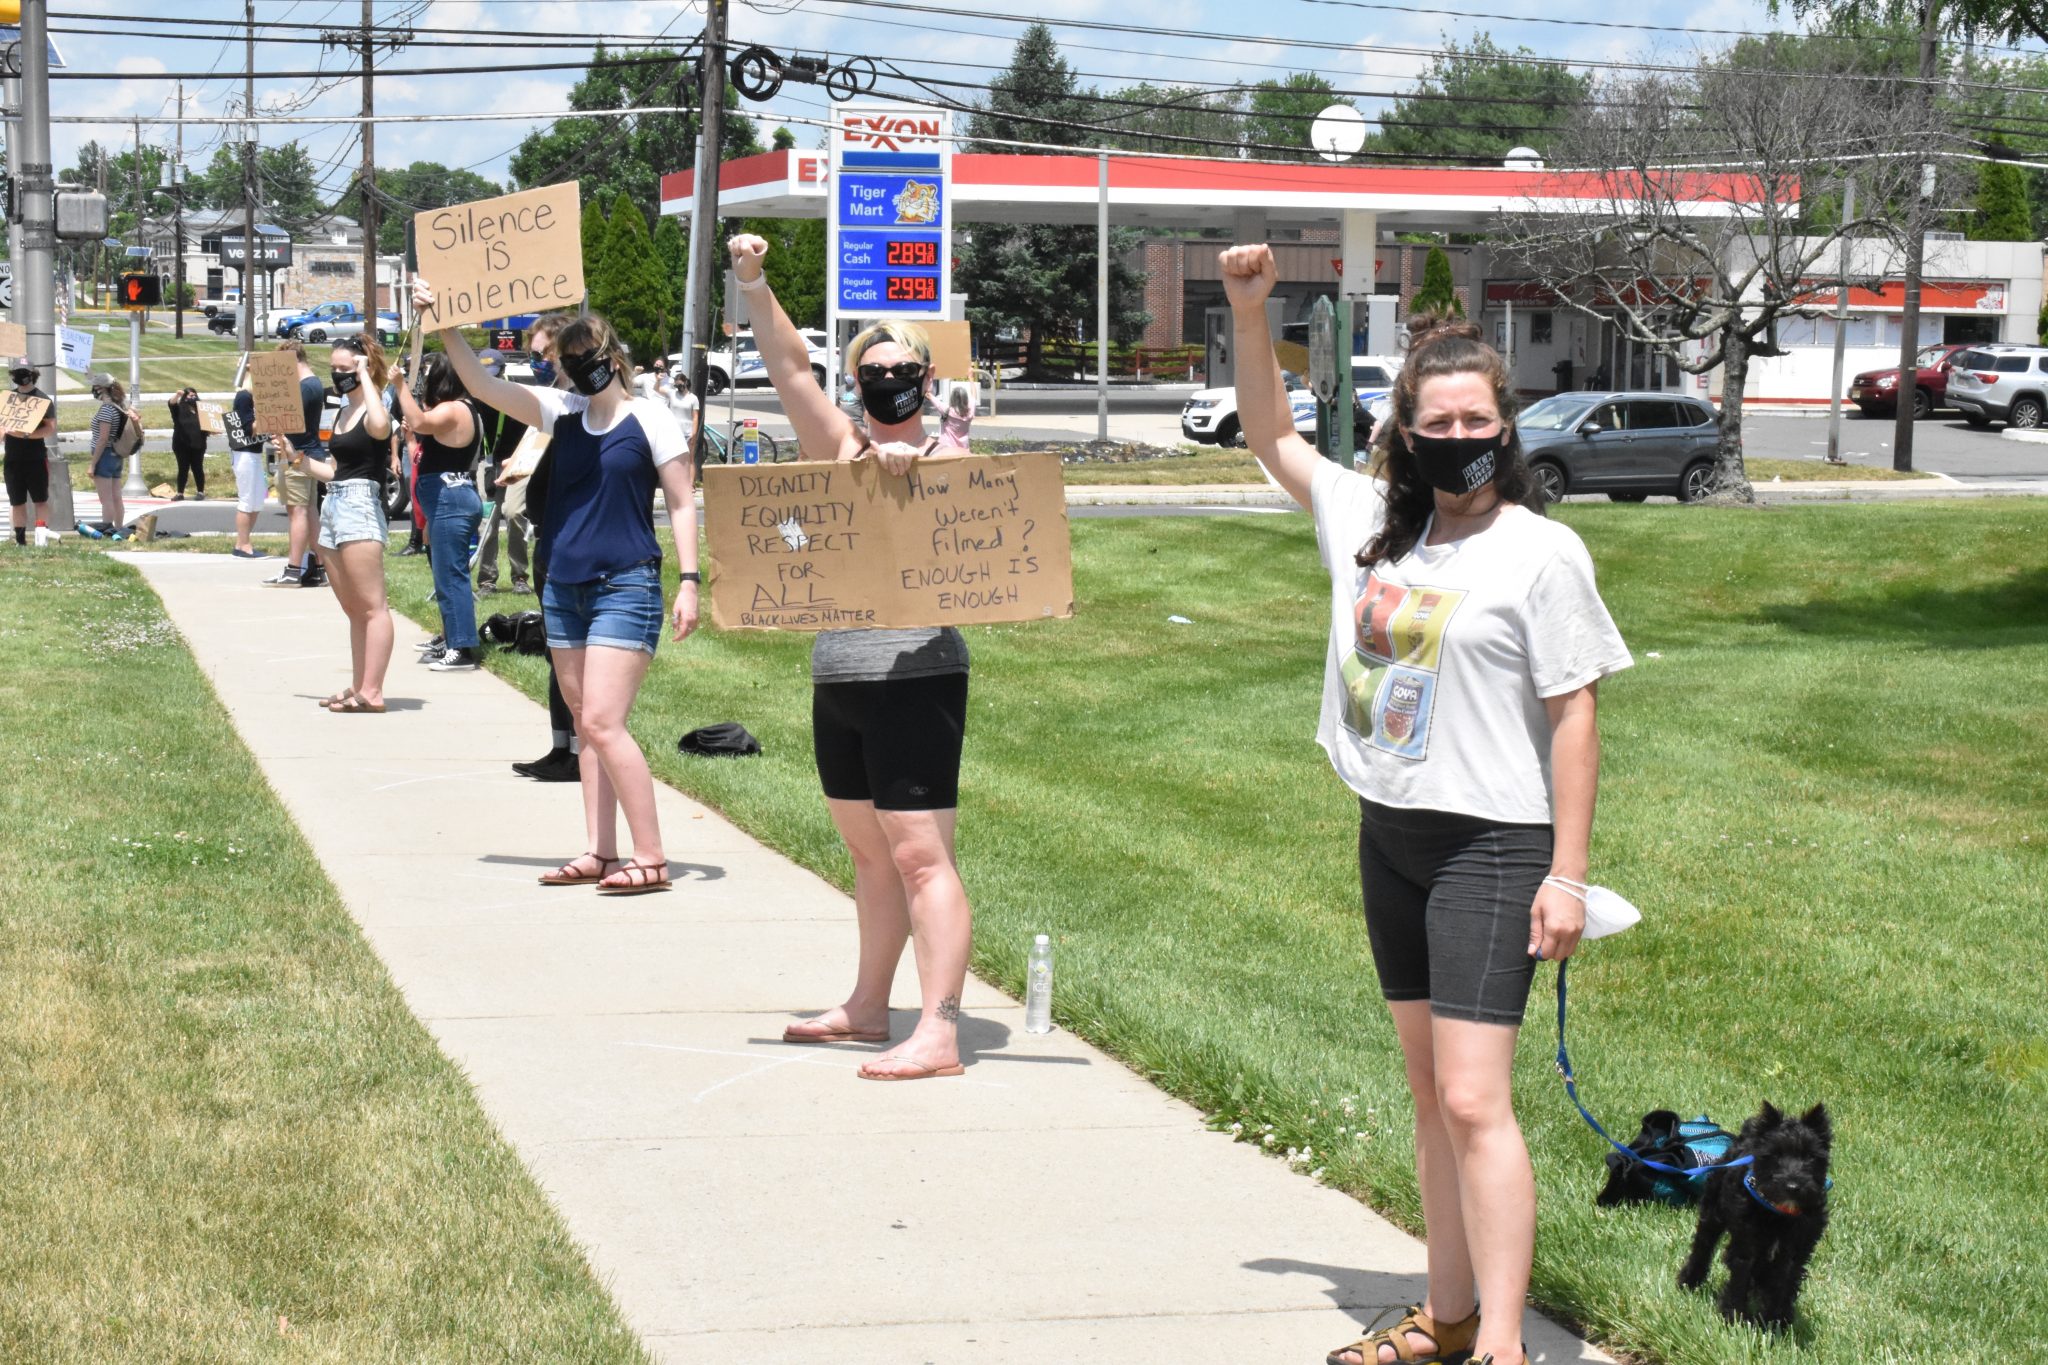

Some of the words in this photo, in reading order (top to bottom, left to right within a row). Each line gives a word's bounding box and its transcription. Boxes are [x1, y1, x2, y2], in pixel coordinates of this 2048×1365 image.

[843, 116, 940, 151] EXXON
[850, 184, 886, 200] Tiger
[850, 203, 884, 216] Mart
[432, 204, 556, 250] Silence
[486, 241, 511, 271] is
[843, 241, 874, 250] Regular
[843, 254, 871, 264] Cash
[843, 277, 874, 287] Regular
[843, 289, 878, 301] Credit
[259, 413, 304, 432] DENIED
[1463, 452, 1493, 478] BLACK
[1471, 463, 1492, 483] LIVES
[739, 471, 831, 497] DIGNITY
[907, 472, 949, 500] How
[968, 469, 1019, 500] Many
[741, 501, 854, 528] EQUALITY
[935, 499, 1019, 527] Weren't
[747, 532, 860, 555] RESPECT
[777, 562, 825, 581] FOR
[901, 561, 990, 590] ENOUGH
[1008, 557, 1039, 574] IS
[752, 583, 835, 611] ALL
[938, 584, 1018, 609] ENOUGH
[821, 610, 876, 623] MATTER
[1393, 686, 1417, 700] GOYA
[1033, 983, 1049, 992] ICE
